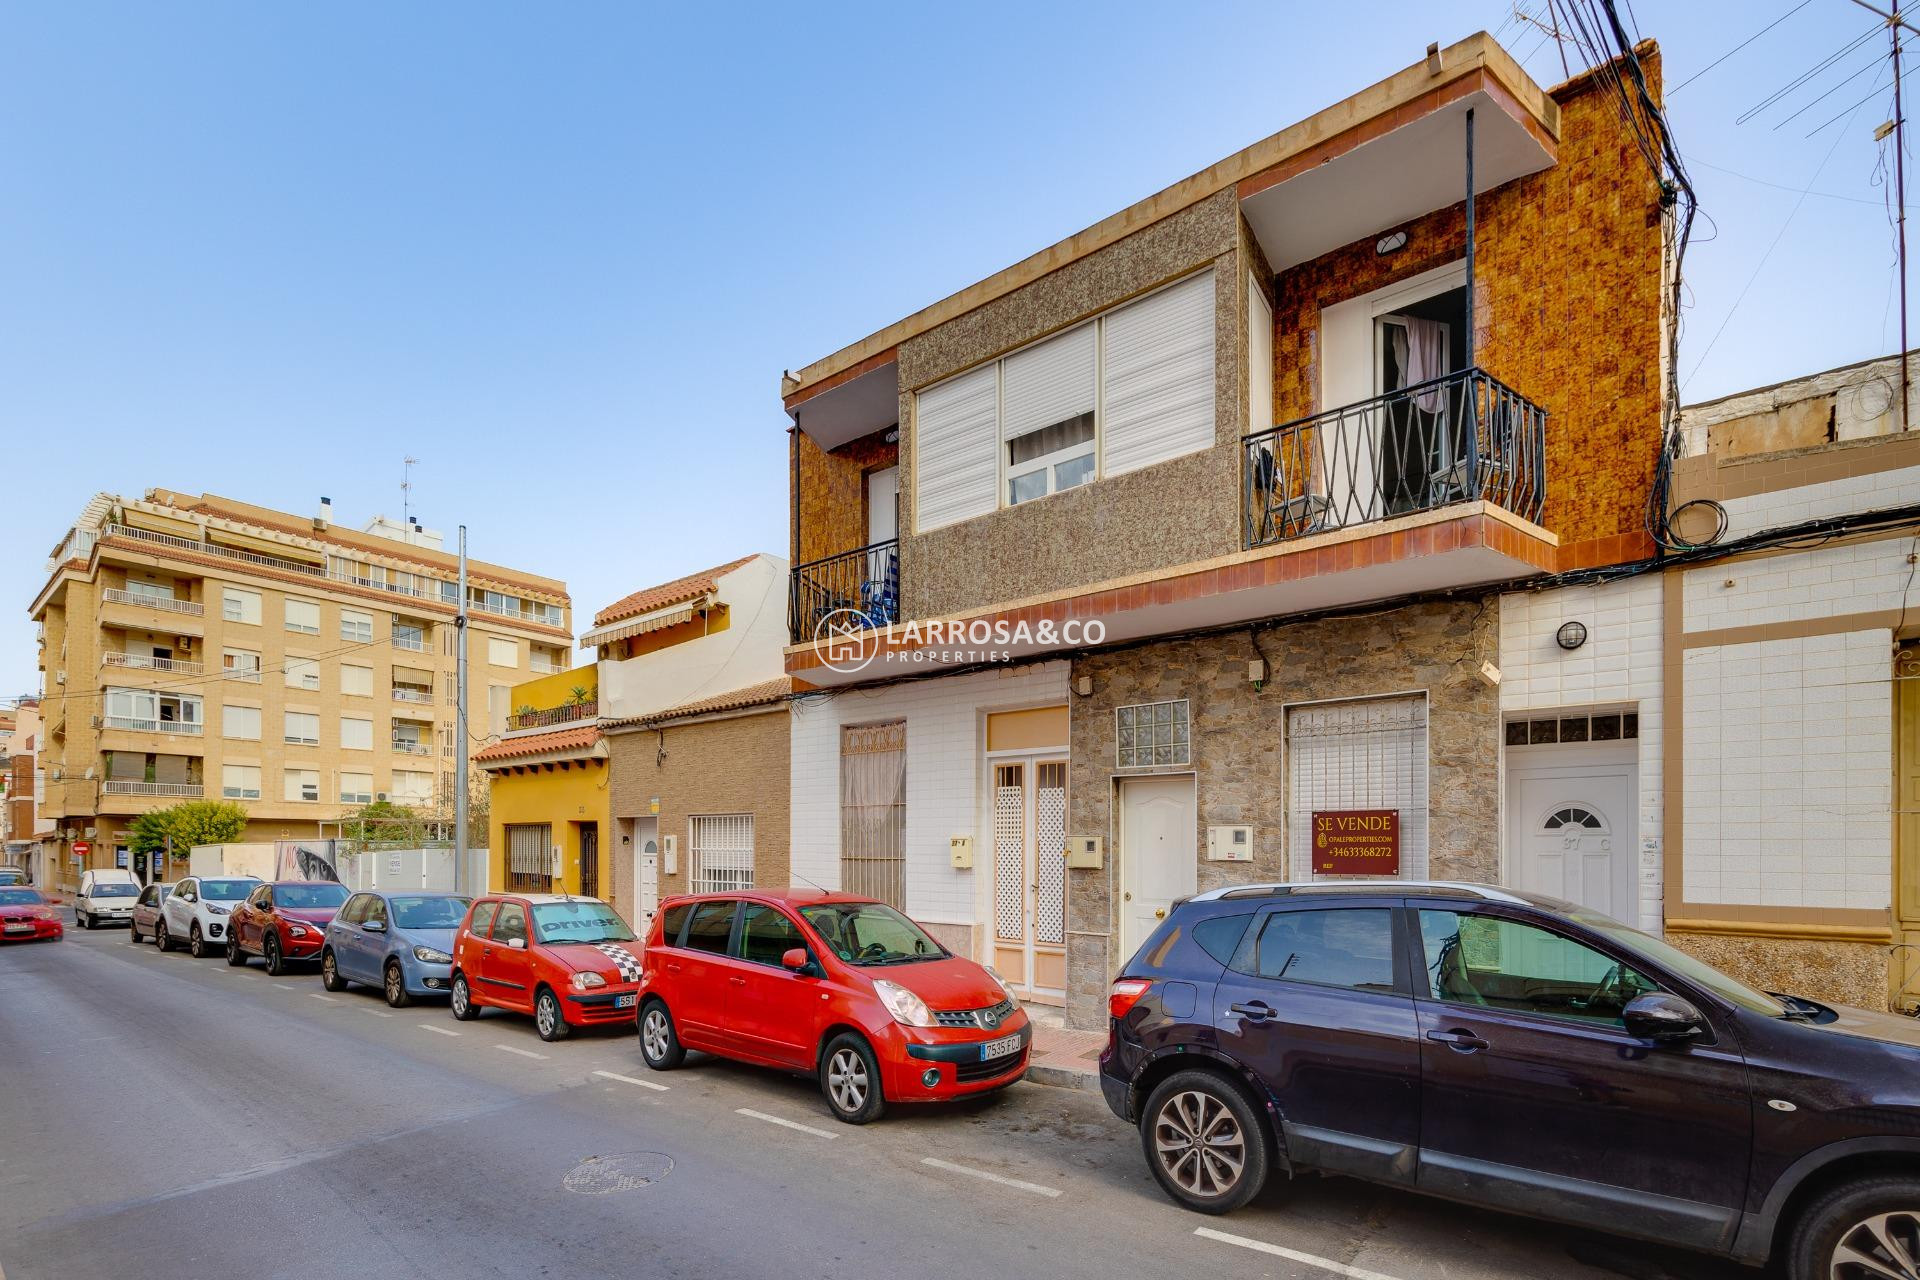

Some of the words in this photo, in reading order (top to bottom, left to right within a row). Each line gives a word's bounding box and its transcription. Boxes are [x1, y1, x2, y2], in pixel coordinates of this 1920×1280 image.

[1317, 817, 1333, 831] SE
[1336, 816, 1392, 831] VENDE
[1328, 836, 1393, 844] OPALEPROPERTIES.COM
[1328, 846, 1392, 857] +34633368272
[986, 1040, 1006, 1059] 7535
[1007, 1036, 1020, 1053] FCJ
